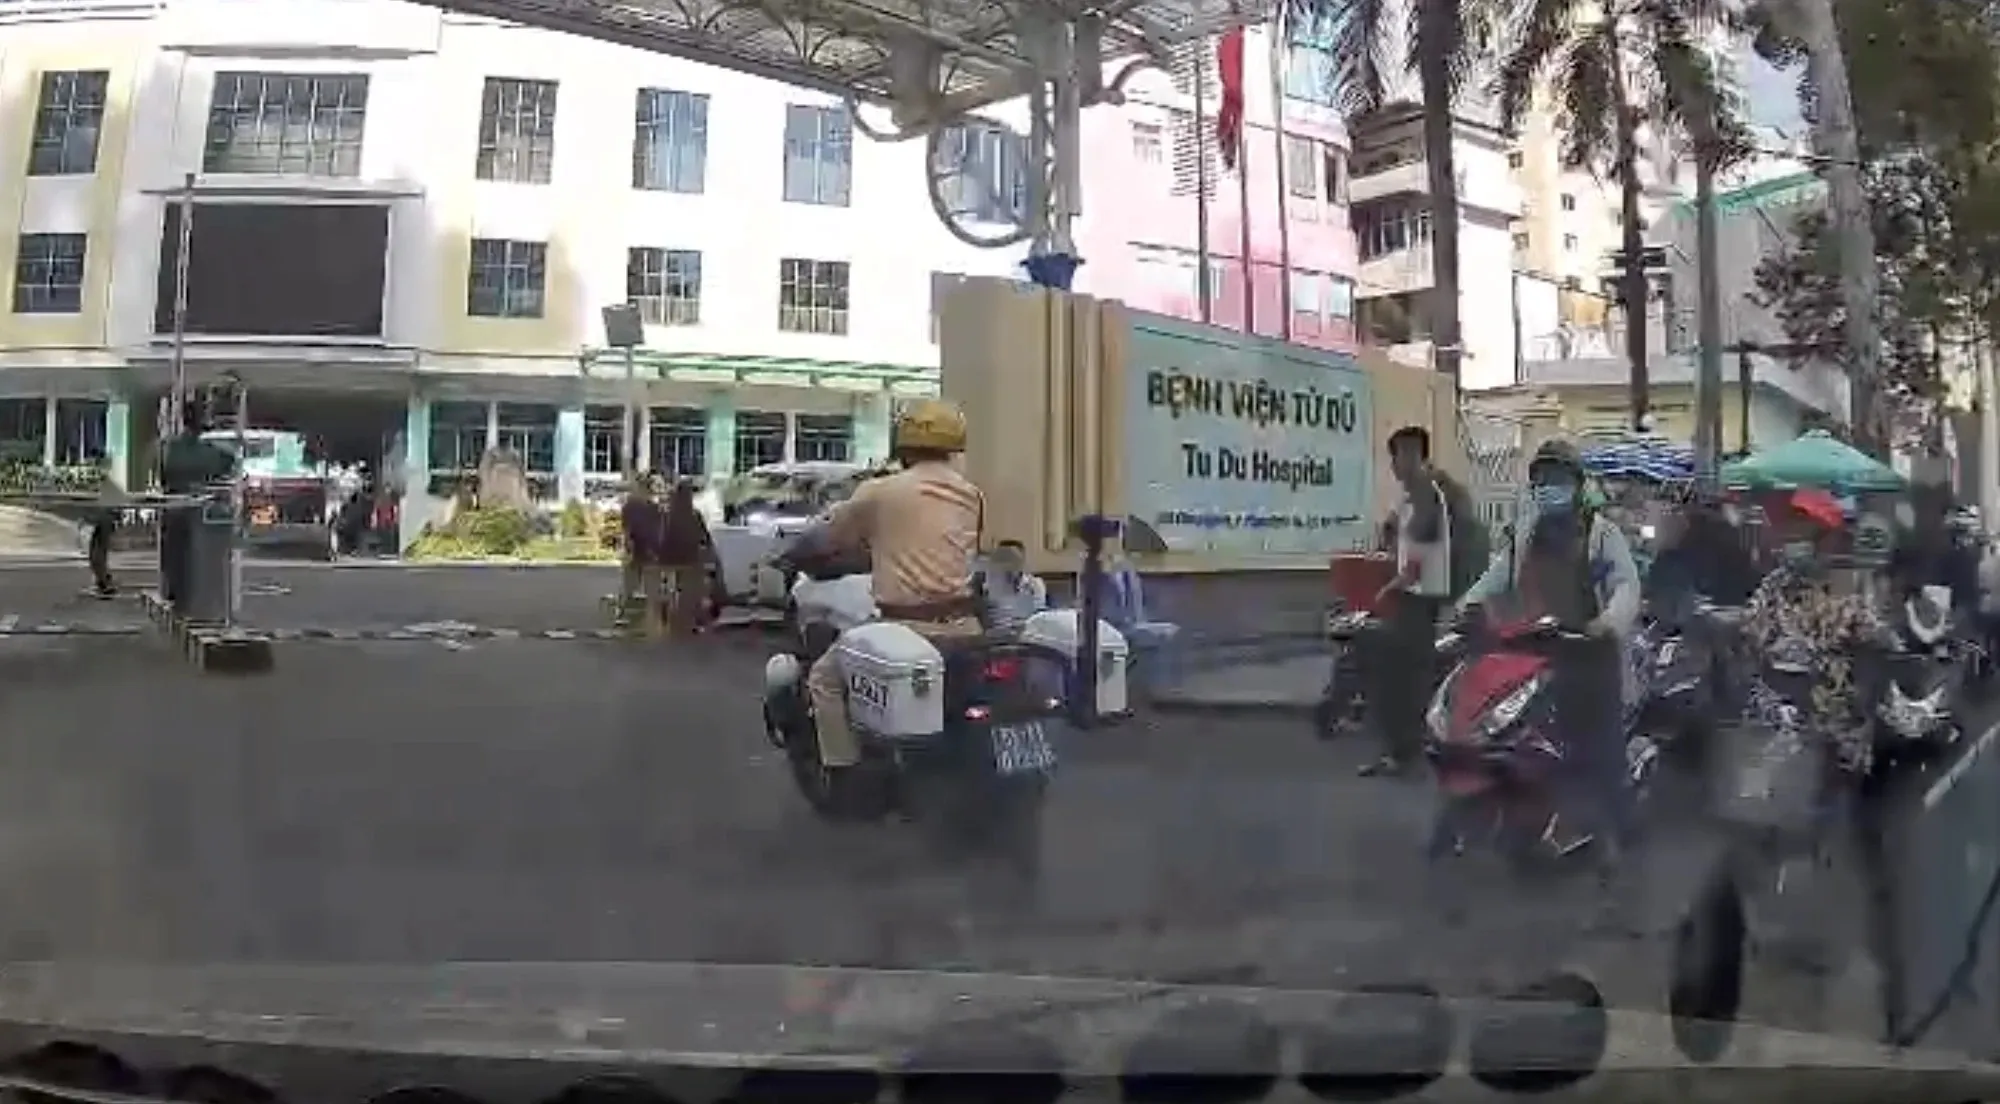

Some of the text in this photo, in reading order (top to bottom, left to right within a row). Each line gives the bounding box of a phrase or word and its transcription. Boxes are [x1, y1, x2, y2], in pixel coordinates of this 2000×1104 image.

[1148, 367, 1222, 419] BỆNH
[1227, 378, 1287, 428] VIỆN
[1181, 443, 1334, 492] Tu Du Hospital
